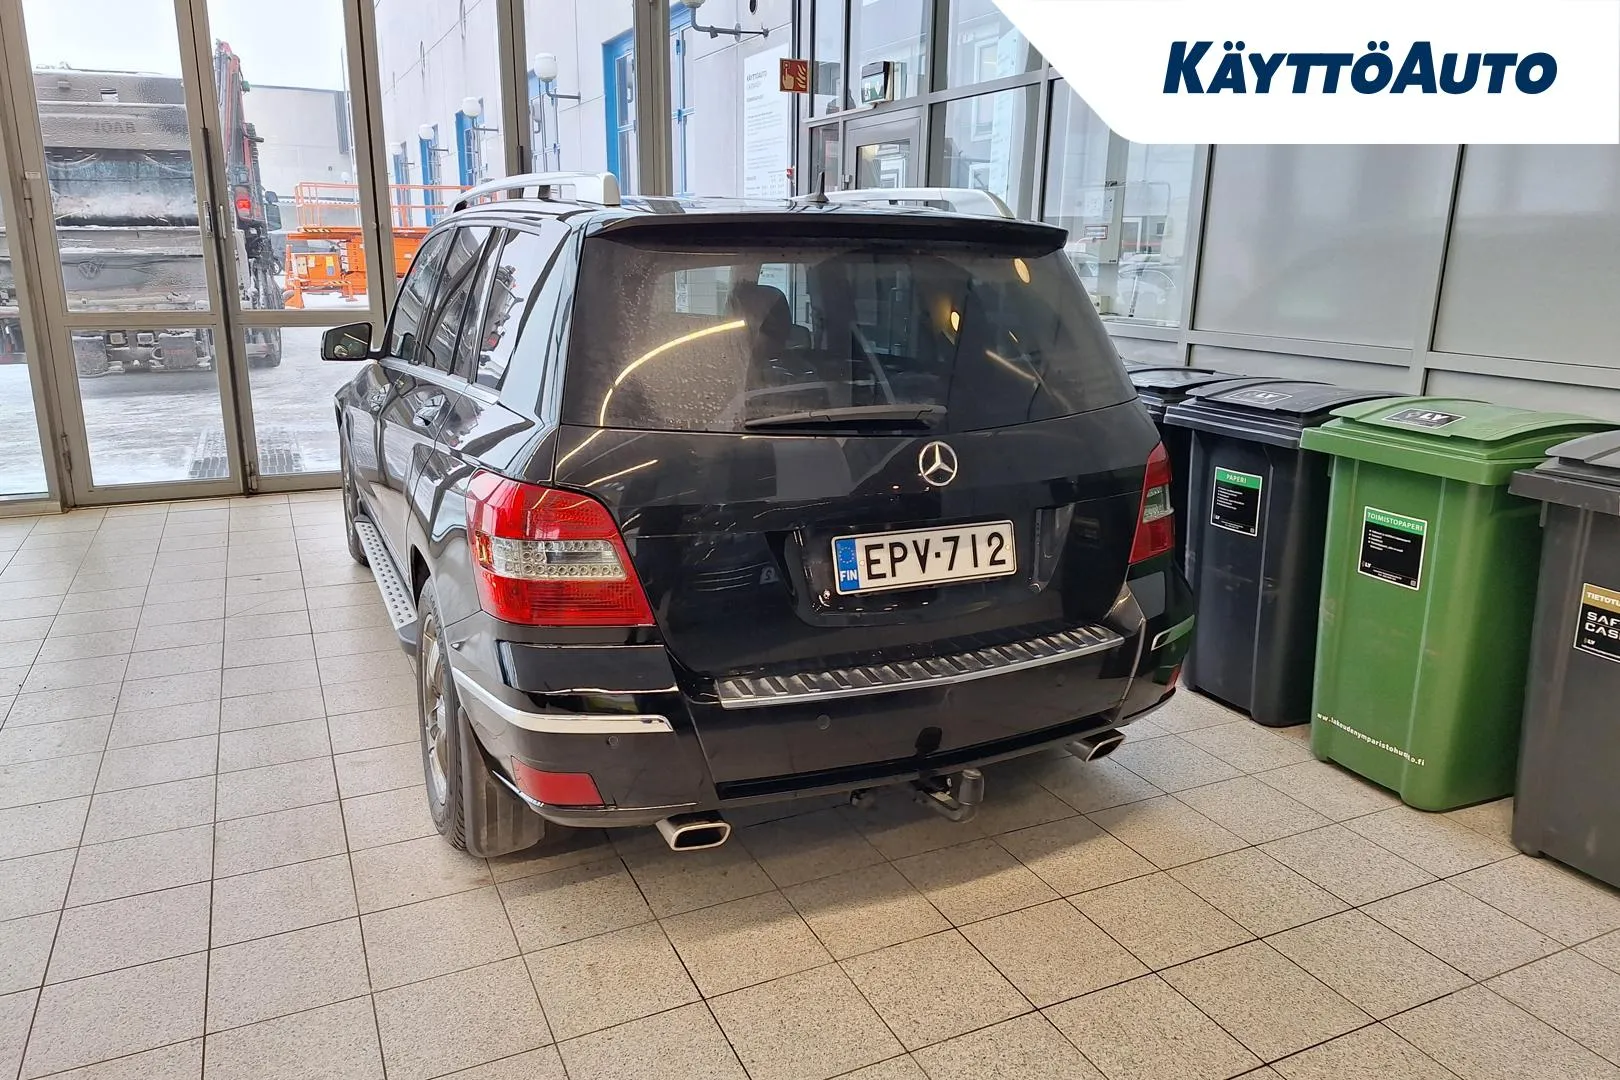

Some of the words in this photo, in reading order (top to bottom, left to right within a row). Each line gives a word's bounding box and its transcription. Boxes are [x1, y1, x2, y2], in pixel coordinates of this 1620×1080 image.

[1226, 473, 1247, 484] PAPERI
[1367, 511, 1423, 532] TOIMISTOPAPERI
[839, 569, 858, 582] FIN
[1584, 622, 1620, 640] CAS
